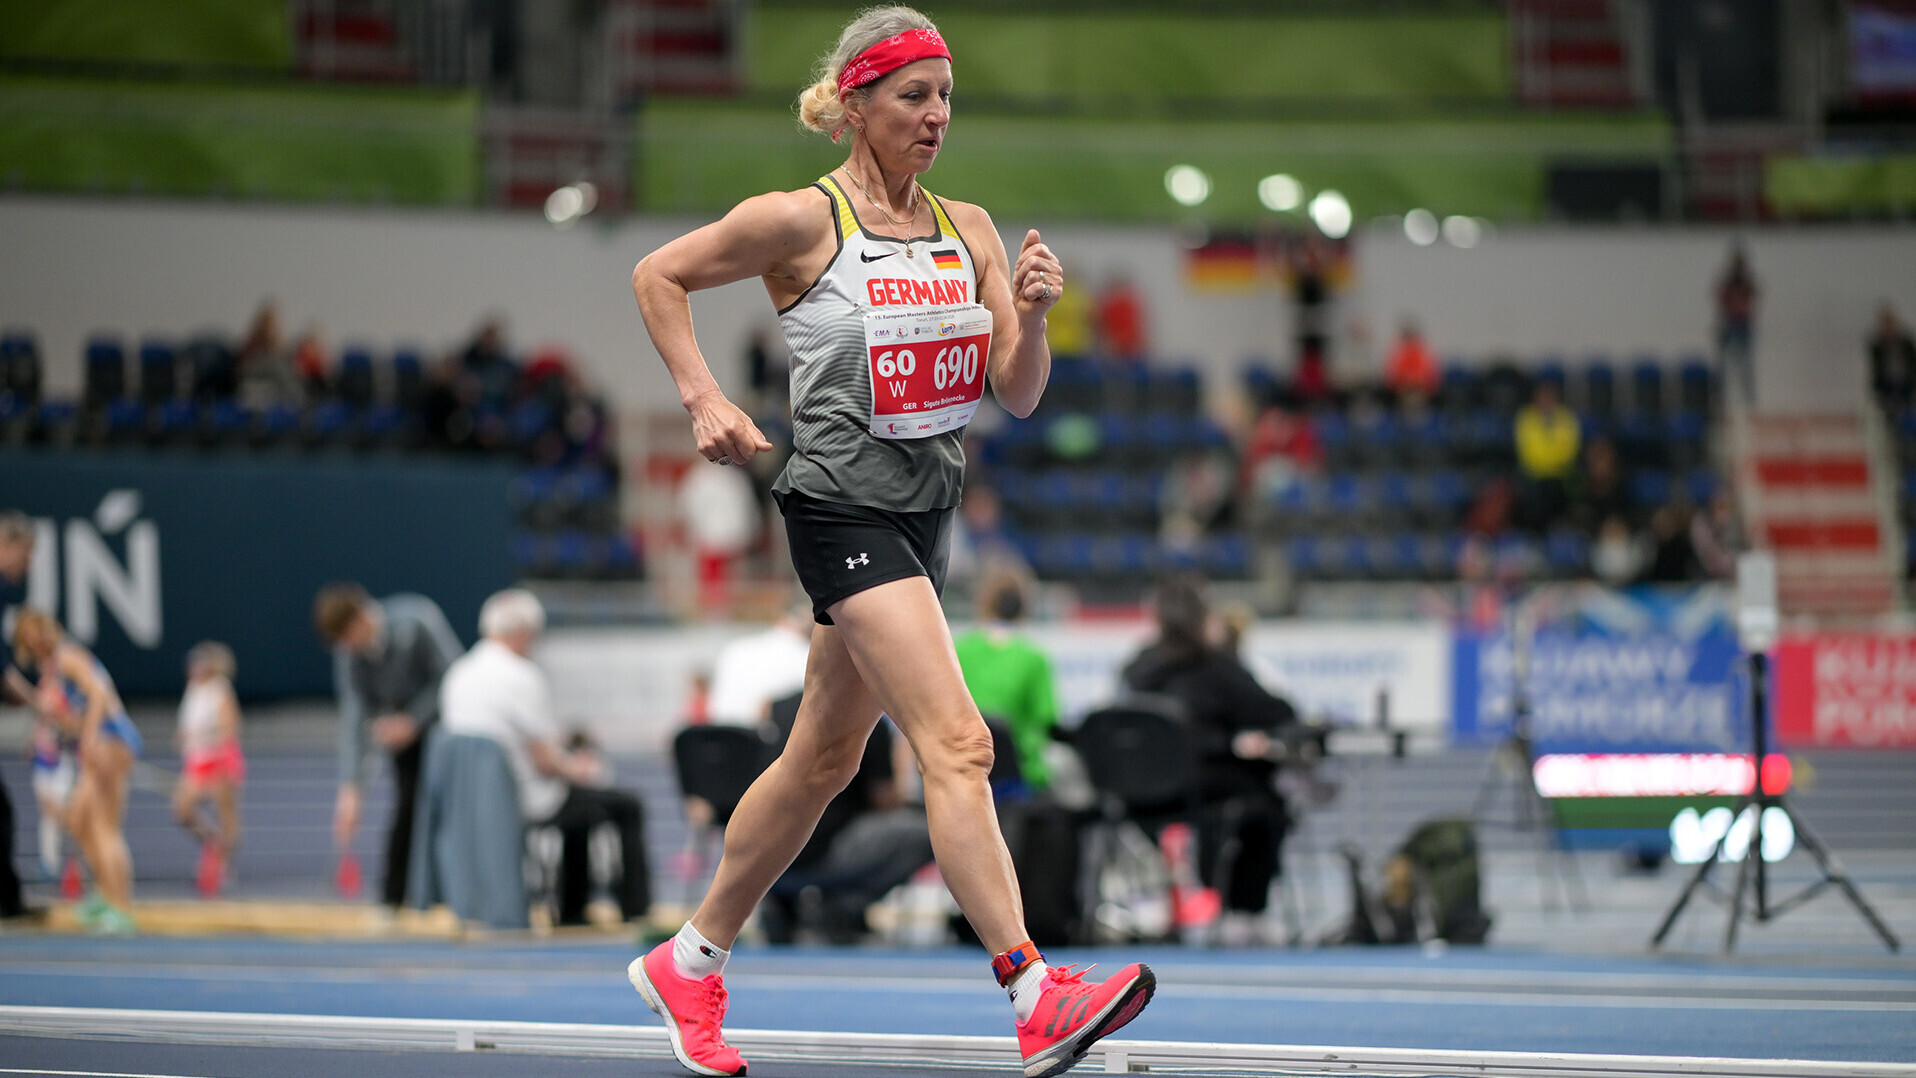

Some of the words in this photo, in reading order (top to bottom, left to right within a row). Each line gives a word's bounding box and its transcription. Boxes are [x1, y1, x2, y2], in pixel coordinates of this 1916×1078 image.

[866, 278, 968, 307] GERMANY
[877, 349, 916, 378] 60
[934, 343, 979, 390] 690
[889, 379, 907, 398] W
[902, 402, 917, 410] GER
[923, 399, 941, 409] Sigute
